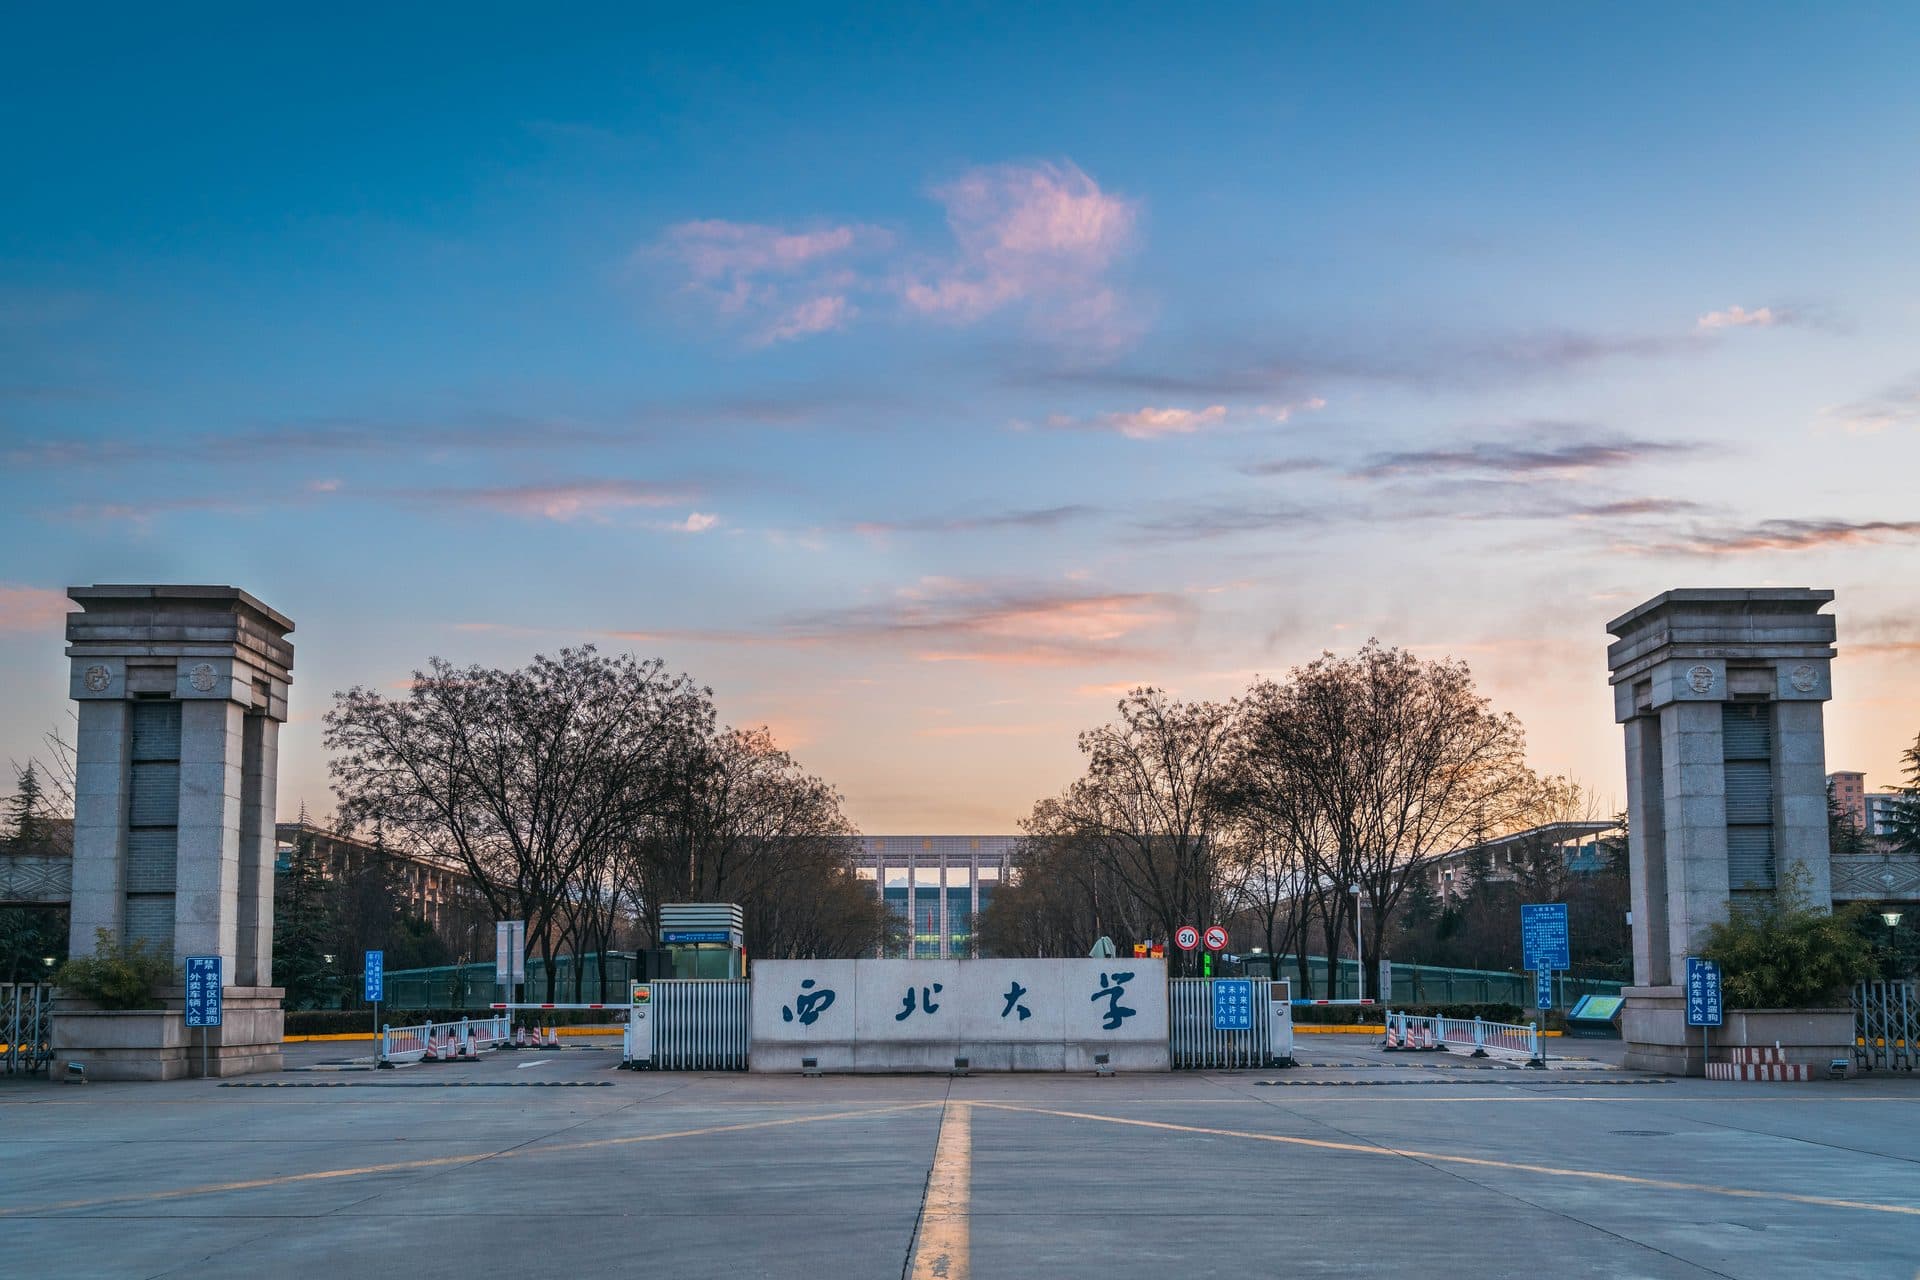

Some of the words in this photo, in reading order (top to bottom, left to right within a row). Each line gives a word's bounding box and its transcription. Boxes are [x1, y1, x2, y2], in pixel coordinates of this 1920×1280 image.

[1180, 933, 1194, 943] 30
[193, 959, 214, 970] 严禁
[782, 972, 1137, 1030] 西北大学
[1218, 985, 1226, 1025] 禁止入内
[1228, 985, 1237, 1025] 未经许可
[1239, 985, 1248, 1025] 外来车辆
